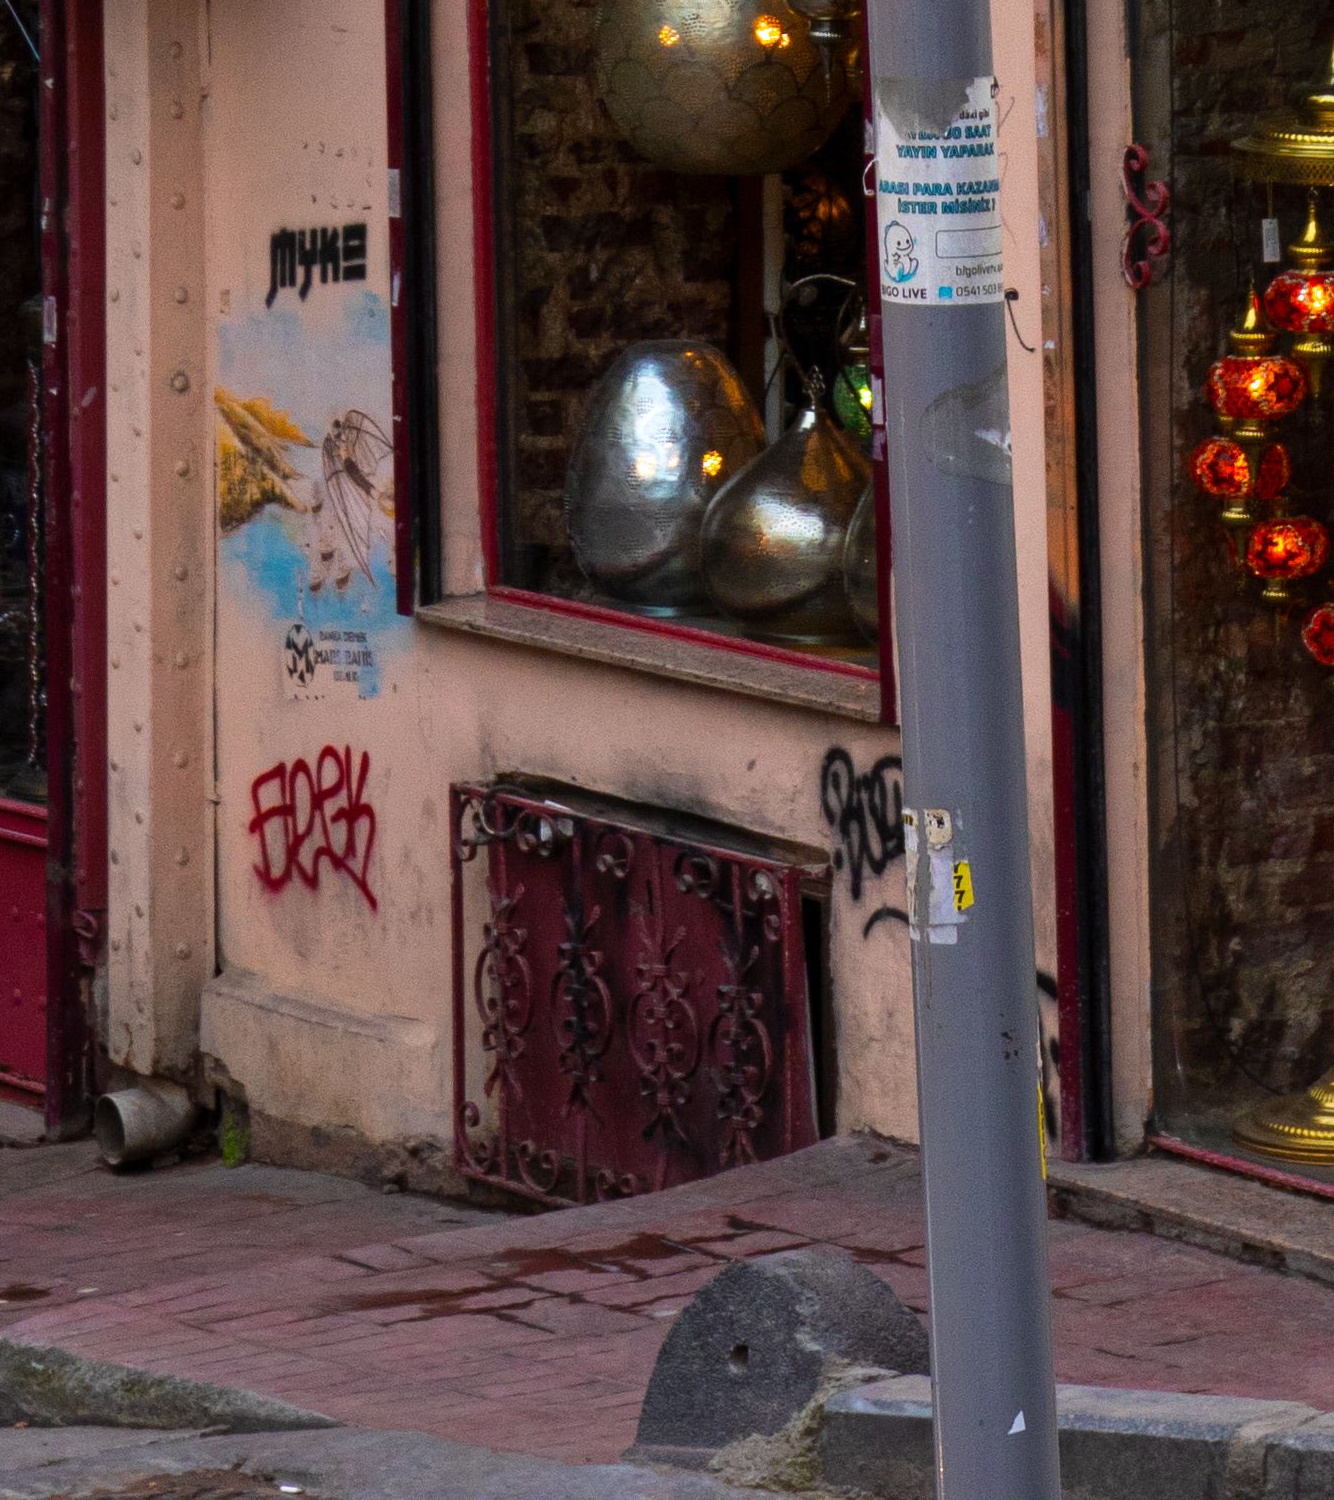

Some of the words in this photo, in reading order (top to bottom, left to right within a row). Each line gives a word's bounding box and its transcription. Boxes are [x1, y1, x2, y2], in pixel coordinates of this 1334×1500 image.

[965, 124, 991, 139] SAAT
[913, 183, 953, 195] PARA
[902, 288, 927, 299] LIVE
